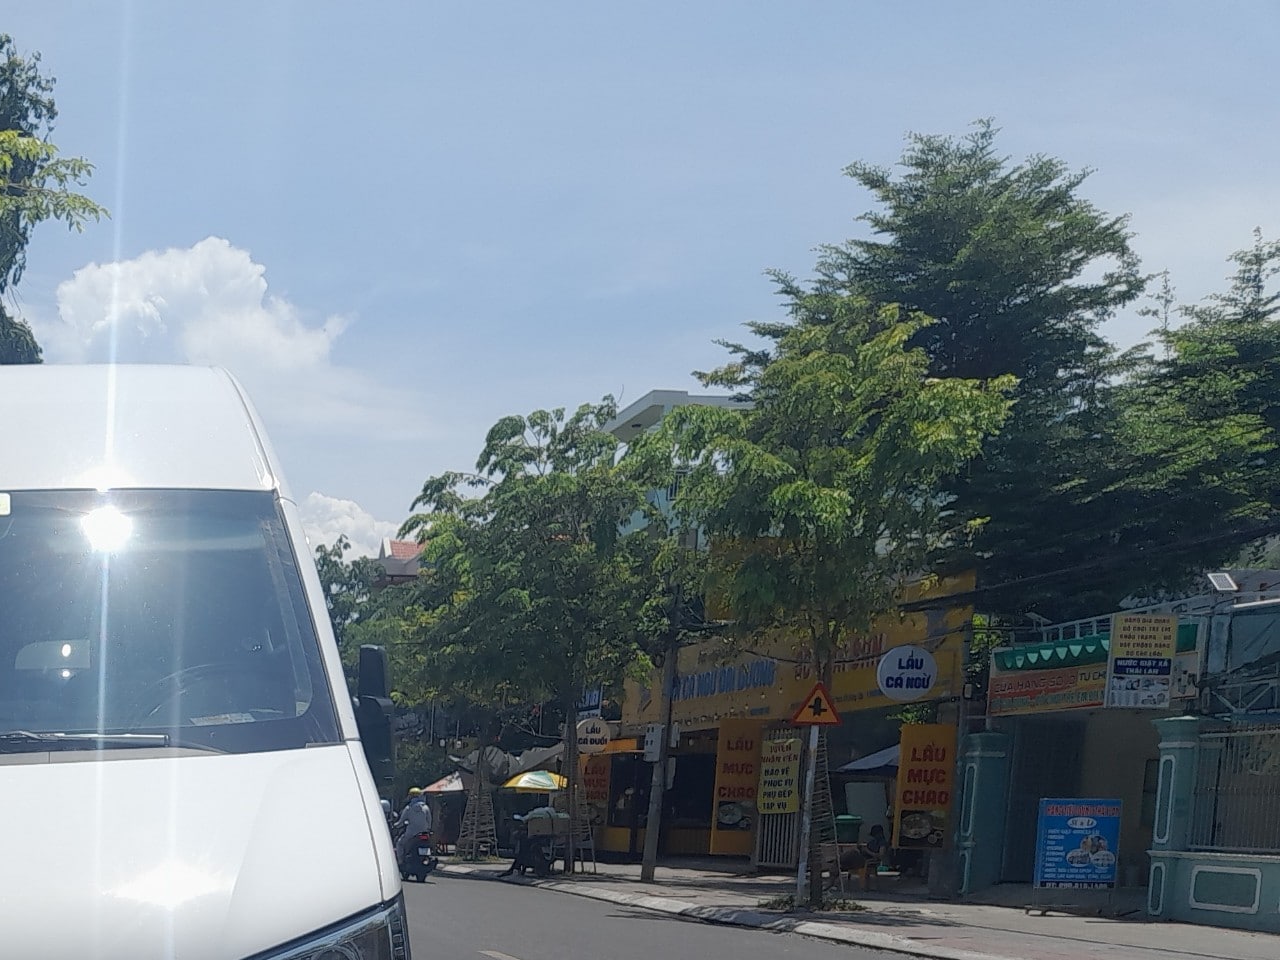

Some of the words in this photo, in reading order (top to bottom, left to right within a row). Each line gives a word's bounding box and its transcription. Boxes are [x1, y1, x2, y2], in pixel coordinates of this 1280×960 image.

[886, 672, 903, 688] CÁ
[906, 673, 931, 689] NGỪ
[907, 768, 946, 785] MỰC
[718, 786, 755, 799] CHAO
[902, 790, 949, 805] CHAO
